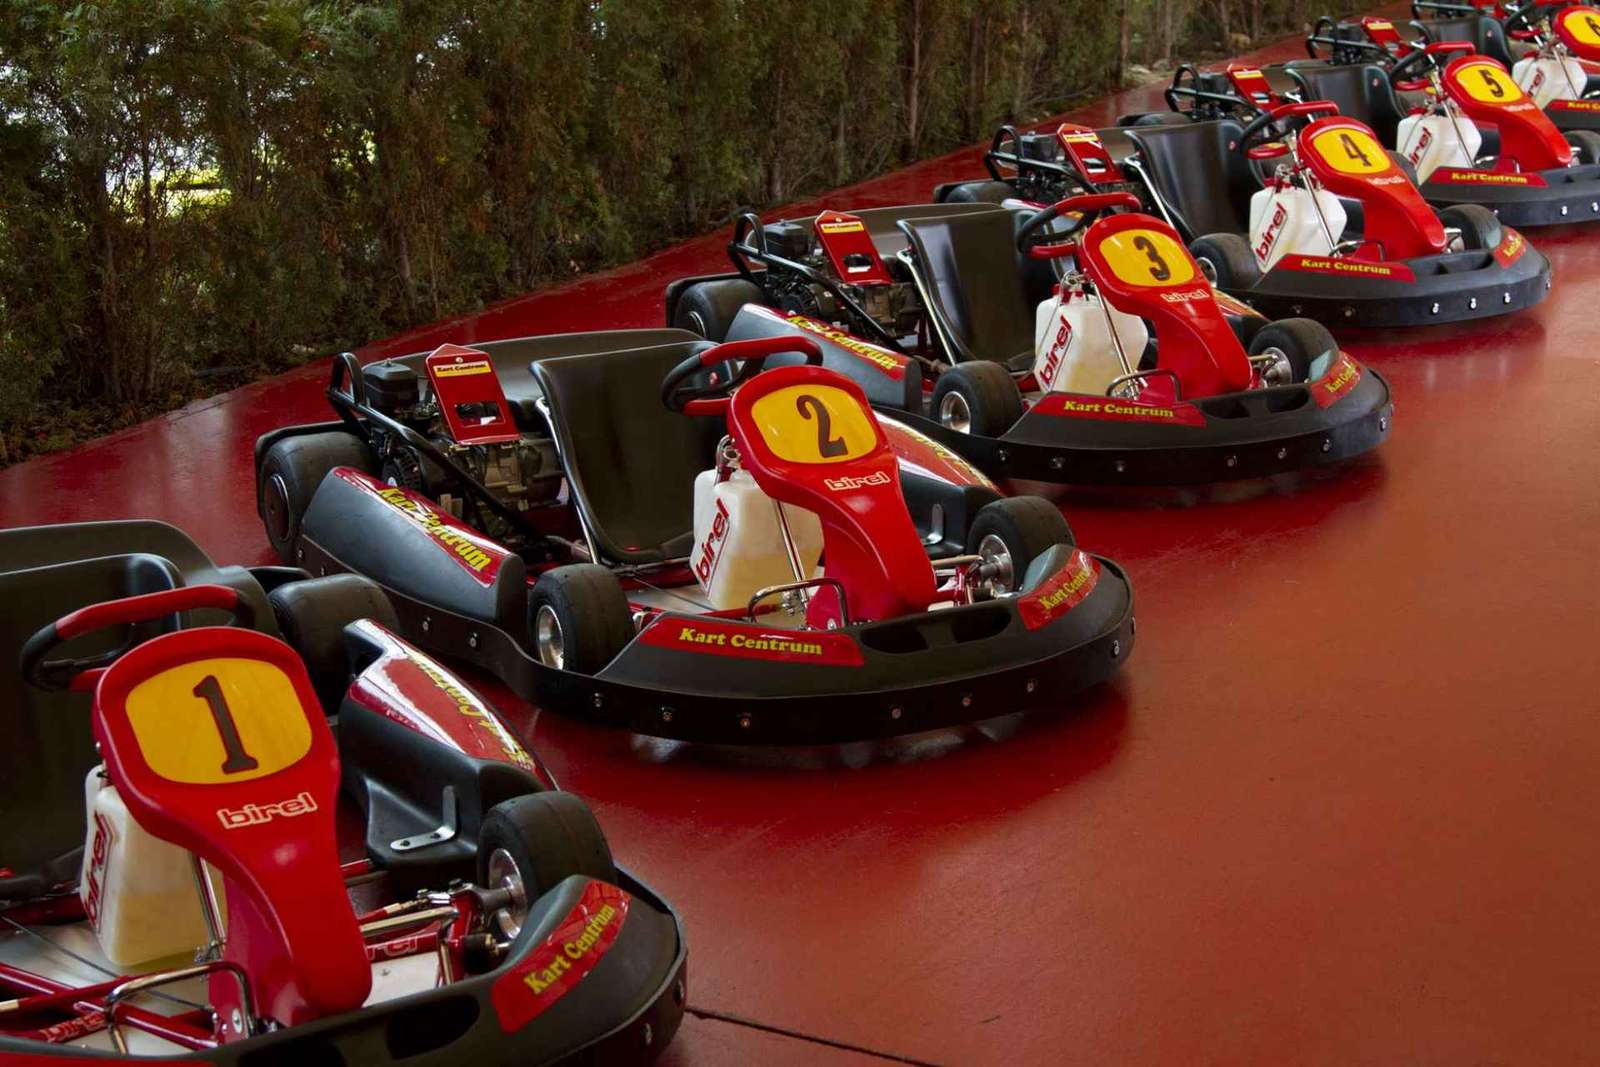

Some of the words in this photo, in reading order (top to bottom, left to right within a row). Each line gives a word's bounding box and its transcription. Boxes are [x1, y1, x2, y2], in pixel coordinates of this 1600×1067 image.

[1478, 69, 1504, 97] 5
[1340, 133, 1372, 167] 4
[1254, 202, 1287, 260] birel
[1133, 235, 1171, 281] 3
[1301, 258, 1331, 269] Kart
[1333, 260, 1391, 275] Centrum
[1039, 313, 1072, 386] birel
[796, 394, 849, 458] 2
[1063, 400, 1102, 412] Kart
[1103, 403, 1174, 418] Centrum
[824, 471, 891, 492] birel
[695, 497, 730, 584] birel
[679, 627, 727, 646] Kart
[730, 634, 823, 656] Centrum
[192, 674, 259, 775] 1
[216, 791, 319, 830] birel
[84, 808, 107, 931] birel
[523, 953, 572, 995] Kart
[564, 903, 616, 960] Centrum
